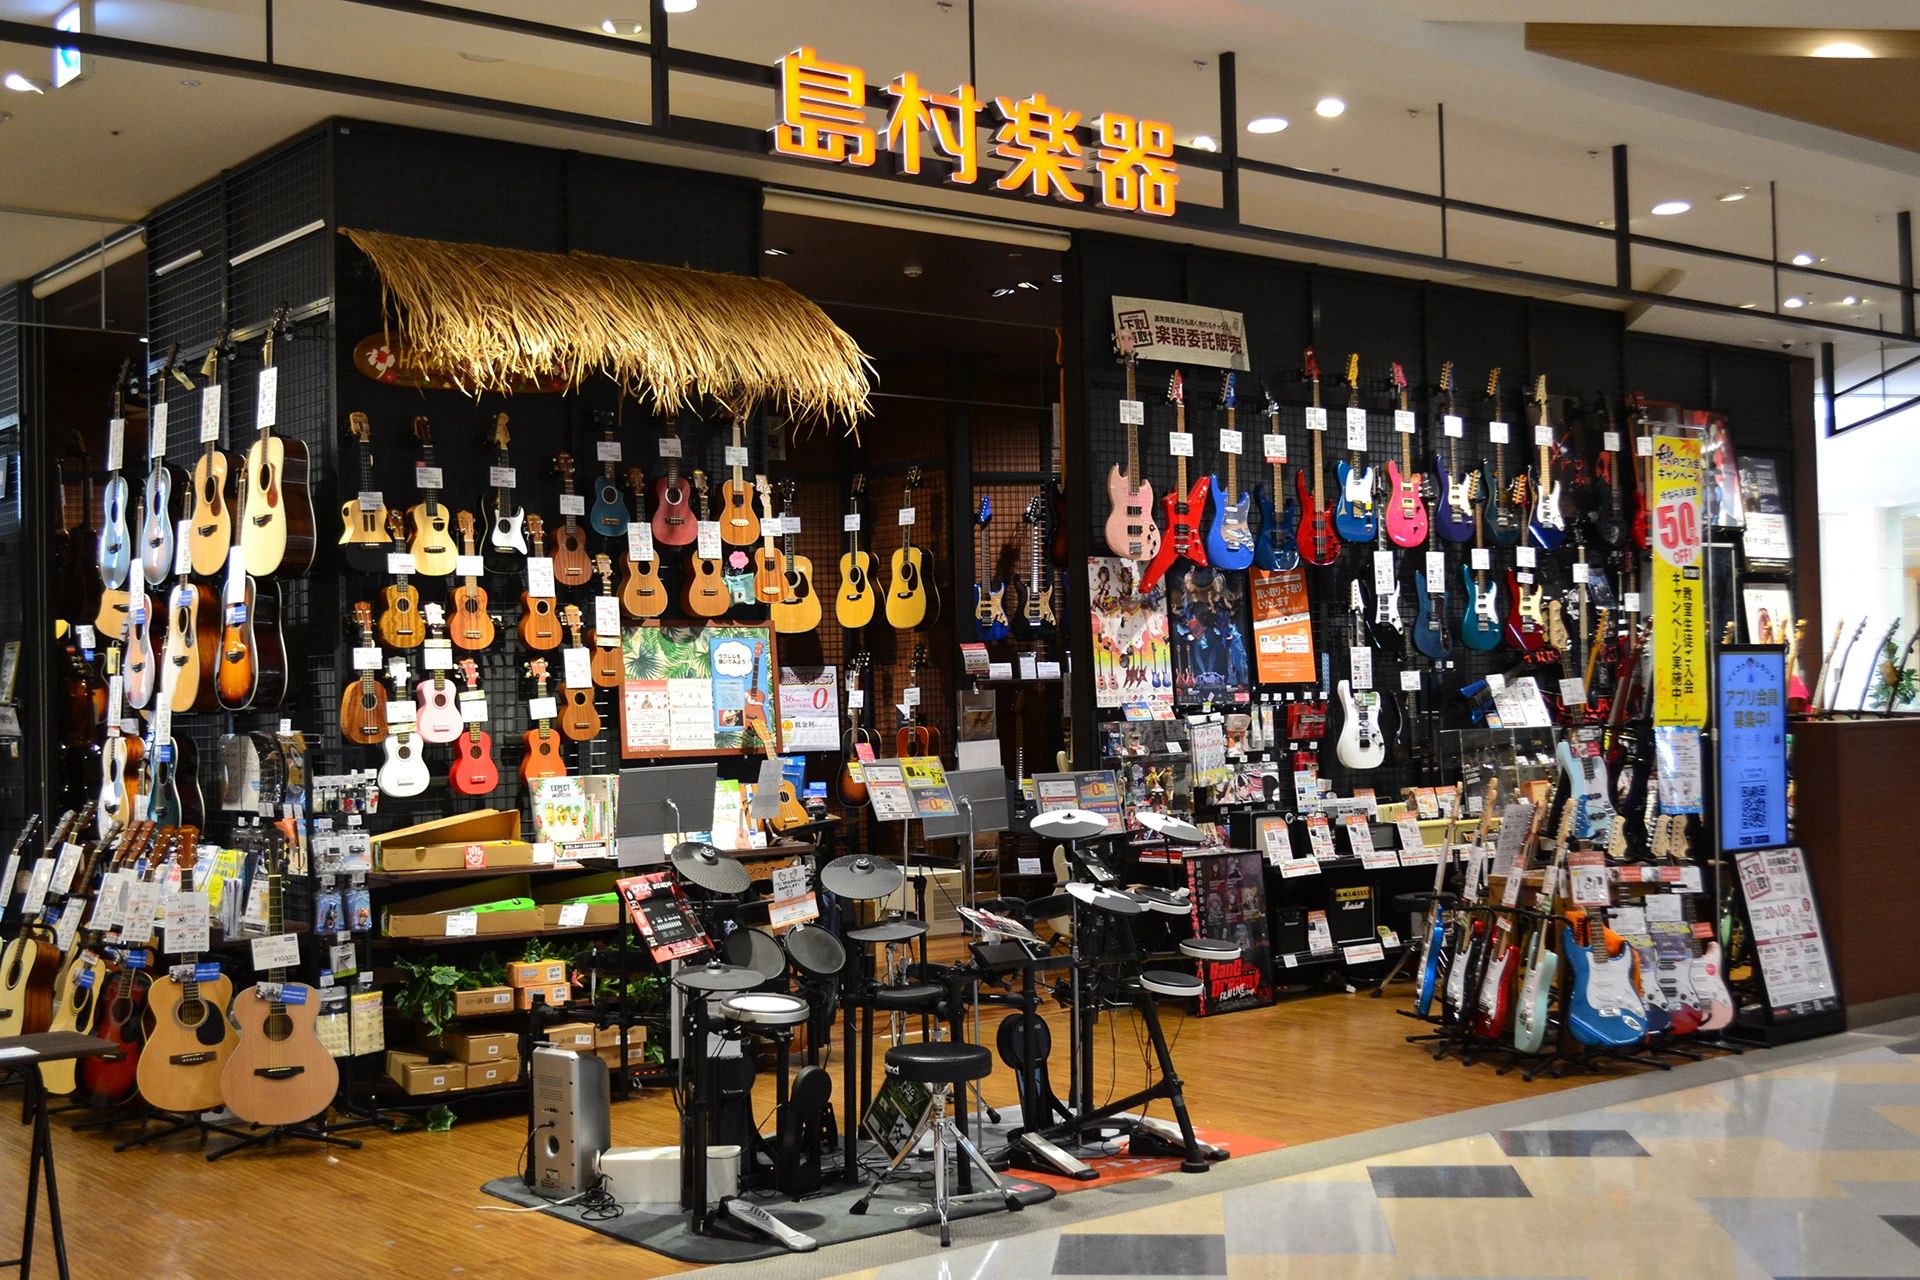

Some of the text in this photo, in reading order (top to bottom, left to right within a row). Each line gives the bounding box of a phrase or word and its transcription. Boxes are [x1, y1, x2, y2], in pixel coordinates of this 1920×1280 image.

[771, 46, 1180, 217] 島村楽器
[1155, 325, 1243, 354] 楽器委託販売
[1725, 688, 1778, 707] アプリ会員
[1195, 860, 1208, 939] 最高の音楽の、その
